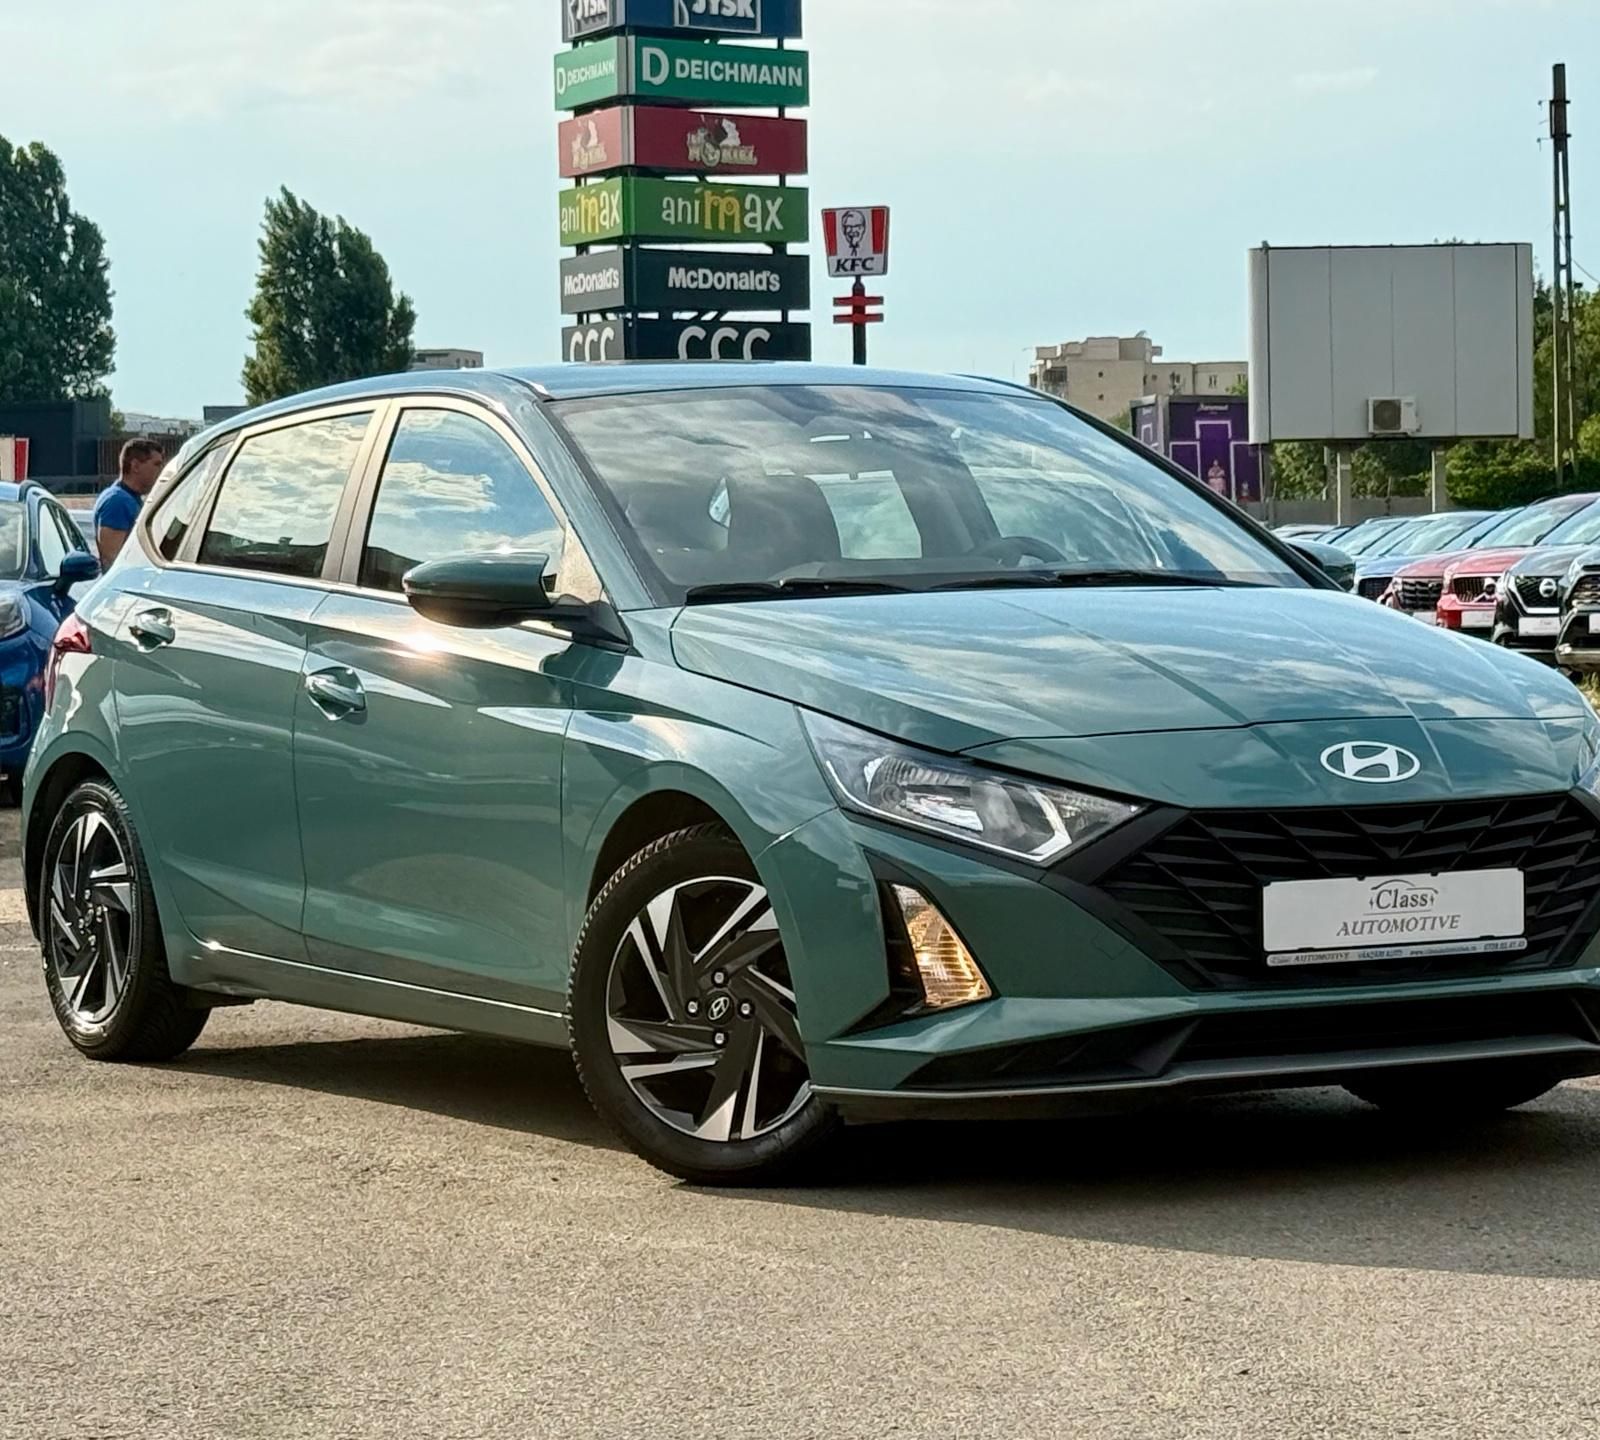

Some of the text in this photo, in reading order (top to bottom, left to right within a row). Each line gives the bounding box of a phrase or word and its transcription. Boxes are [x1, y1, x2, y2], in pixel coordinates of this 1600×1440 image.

[567, 60, 615, 87] DEICHMANN
[675, 57, 803, 87] DEICHMANN
[835, 256, 875, 273] KFC
[564, 267, 620, 297] McDonald's
[668, 266, 780, 293] McDonald's
[1376, 888, 1429, 910] Class
[1336, 914, 1461, 937] AUTOMOTIVE
